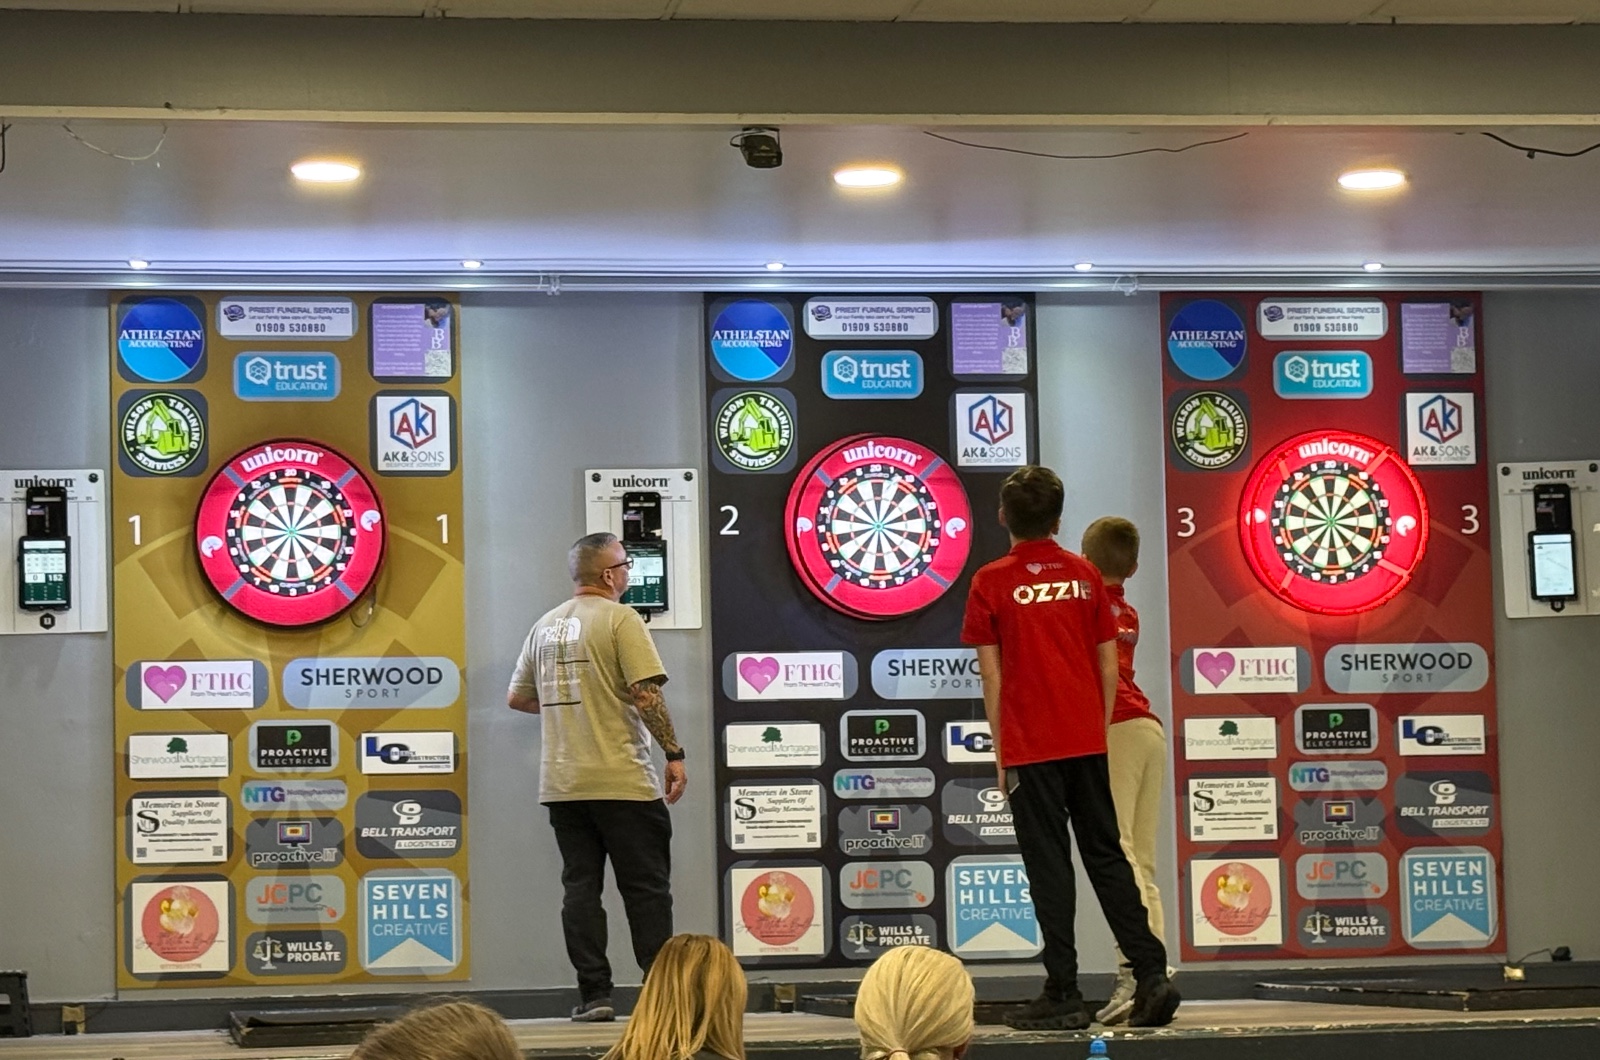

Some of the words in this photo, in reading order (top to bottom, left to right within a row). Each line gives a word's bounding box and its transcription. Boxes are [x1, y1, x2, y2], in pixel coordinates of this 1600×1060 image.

[248, 306, 275, 314] PRIEST
[277, 306, 312, 314] FUNERAL
[313, 306, 350, 314] SERVICES
[835, 306, 860, 314] PRIEST
[861, 306, 895, 314] FUNERAL
[896, 306, 931, 314] SERVICES
[120, 330, 201, 340] ATHELSTAN
[712, 330, 790, 340] ATHELSTAN
[1169, 330, 1244, 340] ATHELSTAN
[128, 340, 193, 348] ACCOUNTING
[721, 340, 782, 348] ACCOUNTING
[1177, 340, 1237, 348] ACCOUNTING
[273, 361, 326, 380] trust
[860, 359, 911, 378] trust
[1311, 359, 1360, 378] trust
[275, 382, 327, 391] EDUCATION
[862, 380, 912, 389] EDUCATION
[1313, 379, 1361, 388] EDUCATION
[125, 400, 153, 441] WILSON
[168, 398, 200, 449] TRAINING
[719, 398, 745, 439] WILSON
[759, 396, 790, 446] TRAINING
[1176, 398, 1201, 438] WILSON
[1215, 396, 1244, 445] TRAINING
[729, 449, 777, 467] SERVICES
[842, 441, 918, 467] unicorn
[1185, 448, 1232, 466] SERVICES
[1298, 438, 1371, 465] unicorn
[136, 452, 186, 470] SERVICES
[240, 446, 320, 472] unicorn
[1522, 467, 1575, 480] unicorn
[14, 475, 74, 488] unicorn
[612, 475, 669, 487] unicorn
[719, 505, 740, 536] 2
[1177, 507, 1196, 538] 3
[1461, 504, 1480, 534] 3
[128, 515, 141, 545] 1
[436, 514, 448, 544] 1
[888, 658, 981, 677] SHERWO
[1240, 658, 1295, 676] FTHC
[1340, 652, 1473, 671] SHERWOOD
[300, 667, 443, 686] SHERWOOD
[784, 664, 841, 681] FTHC
[1382, 673, 1434, 683] SPORT
[192, 673, 251, 690] FTHC
[345, 688, 400, 698] SPORT
[851, 737, 915, 746] PROACTIVE
[1306, 731, 1368, 739] PROACTIVE
[851, 747, 915, 755] ELECTRICAL
[1306, 740, 1368, 748] ELECTRICAL
[261, 749, 328, 757] PROACTIVE
[261, 757, 328, 766] ELECTRICAL
[1291, 767, 1330, 783] NTG
[836, 774, 875, 791] NTG
[1196, 781, 1235, 789] Memories
[1246, 780, 1269, 788] Stone
[244, 786, 285, 803] NTG
[737, 788, 777, 797] Memories
[779, 788, 787, 796] in
[789, 788, 813, 796] Stone
[139, 800, 182, 809] Memories
[184, 800, 193, 808] in
[195, 800, 220, 808] Stone
[1400, 806, 1426, 816] BELL
[1427, 805, 1489, 816] TRANSPORT
[948, 814, 973, 824] BELL
[975, 813, 1013, 823] TRANS
[361, 827, 388, 837] BELL
[390, 826, 456, 837] TRANSPORT
[403, 840, 440, 848] LOGISTICS
[1305, 860, 1367, 881] JCPC
[1412, 861, 1483, 877] SEVEN
[849, 869, 912, 889] JCPC
[959, 869, 1030, 886] SEVEN
[256, 883, 323, 905] JCPC
[372, 883, 448, 900] SEVEN
[1413, 879, 1484, 896] HILLS
[960, 888, 1031, 905] HILLS
[372, 903, 448, 920] HILLS
[1414, 898, 1485, 912] CREATIVE
[960, 907, 1032, 920] CREATIVE
[1334, 917, 1369, 926] WILLS
[1370, 916, 1379, 925] &
[372, 922, 449, 936] CREATIVE
[878, 926, 912, 935] WILLS
[914, 926, 922, 935] &
[1335, 926, 1386, 936] PROBATE
[286, 942, 322, 951] WILLS
[324, 941, 334, 950] &
[879, 936, 930, 946] PROBATE
[287, 952, 341, 962] PROBATE
